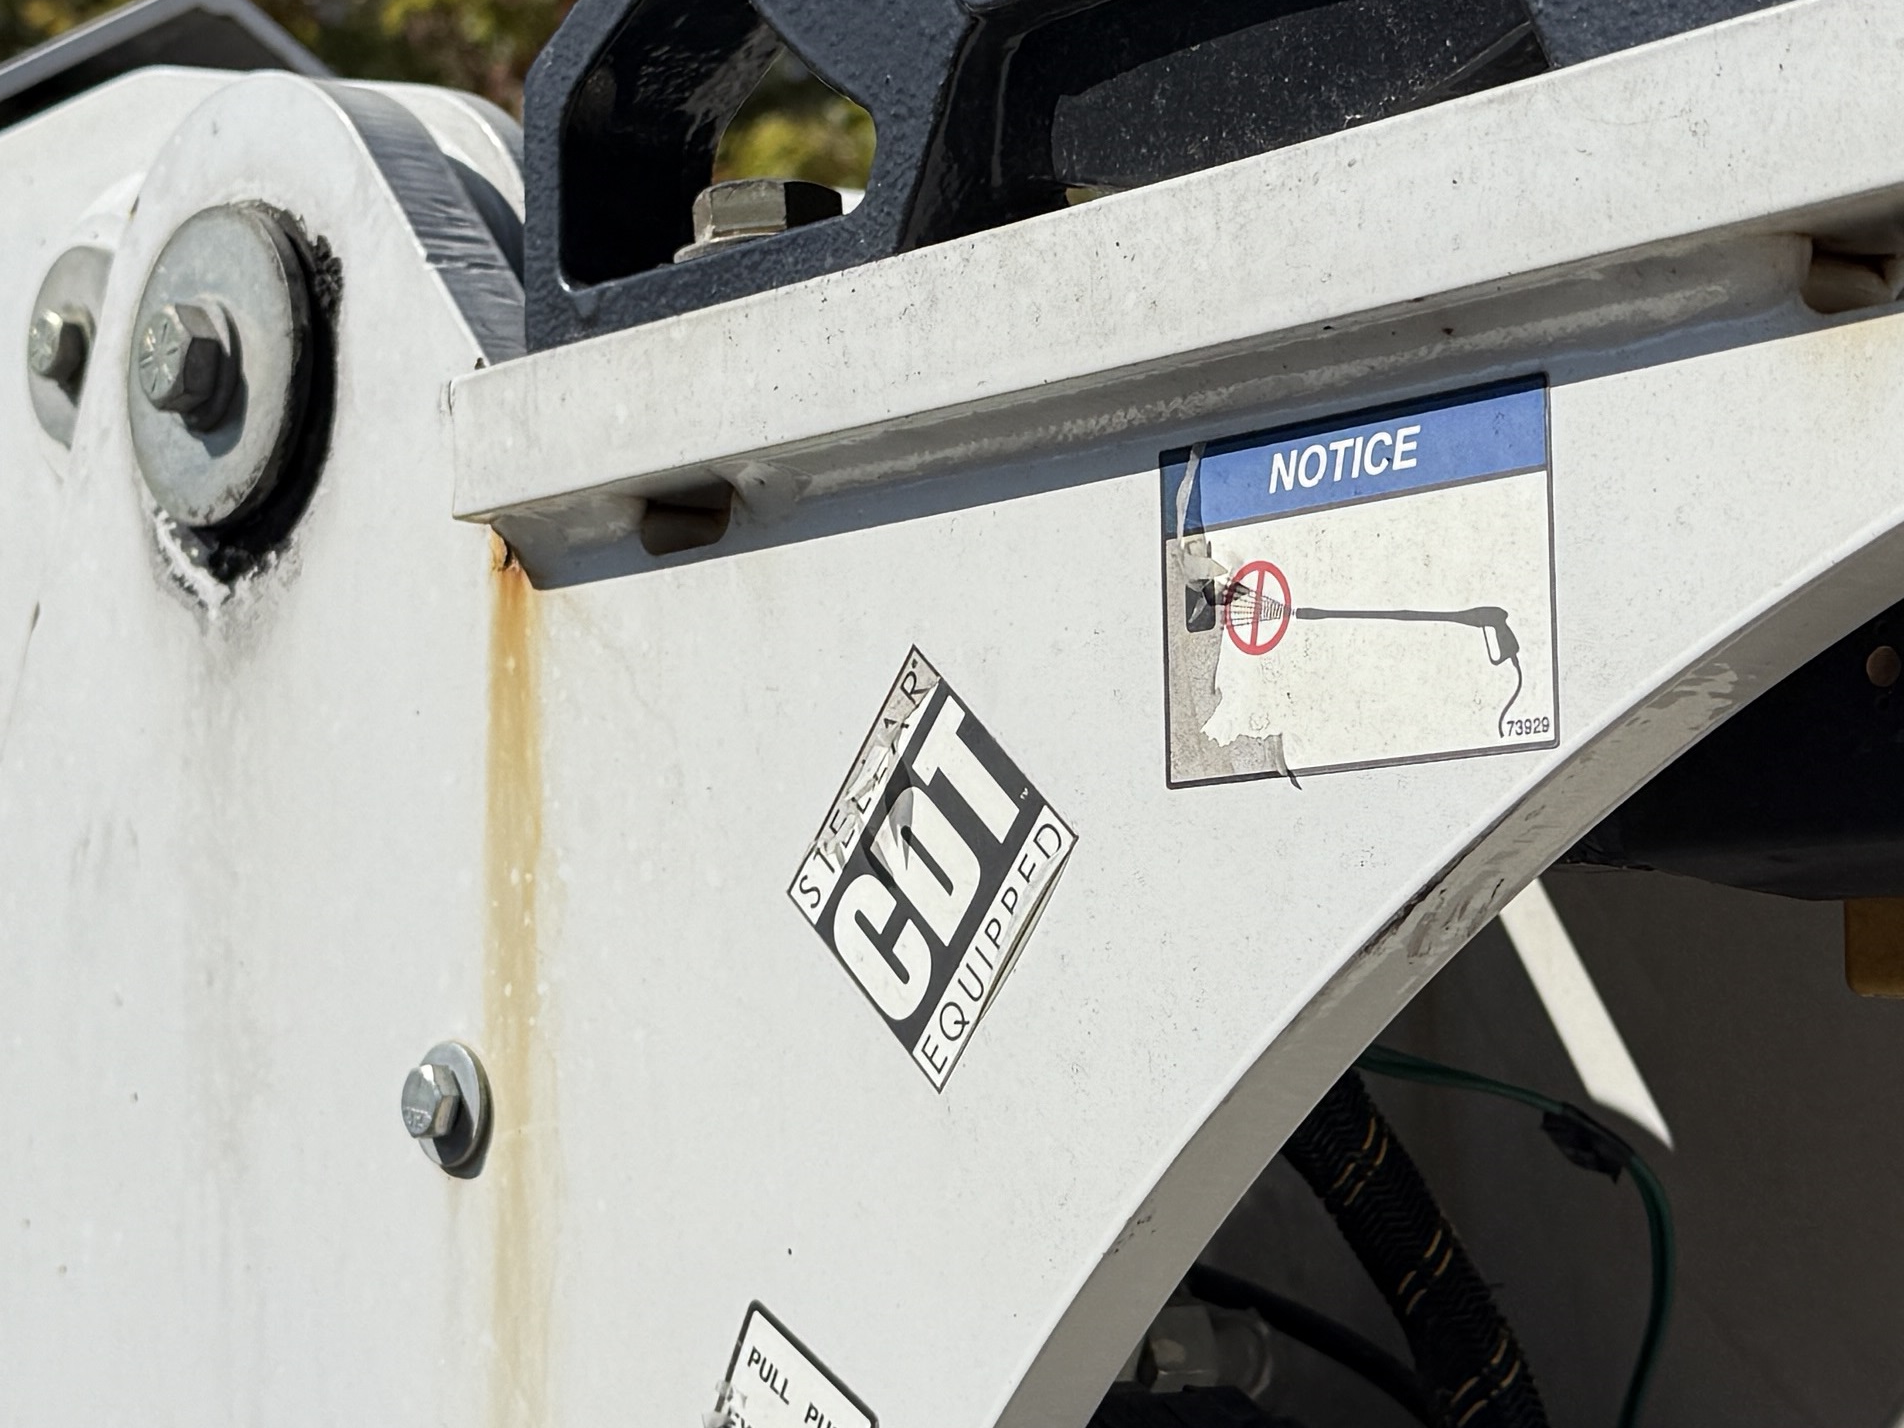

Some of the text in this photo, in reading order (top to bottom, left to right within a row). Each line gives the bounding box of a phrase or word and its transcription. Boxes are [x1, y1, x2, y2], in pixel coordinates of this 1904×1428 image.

[1268, 424, 1421, 494] NOTICE
[1506, 715, 1550, 738] 73929
[833, 694, 1020, 1021] CDT
[921, 822, 1063, 1075] EQUIPPED
[746, 1345, 790, 1406] PULL
